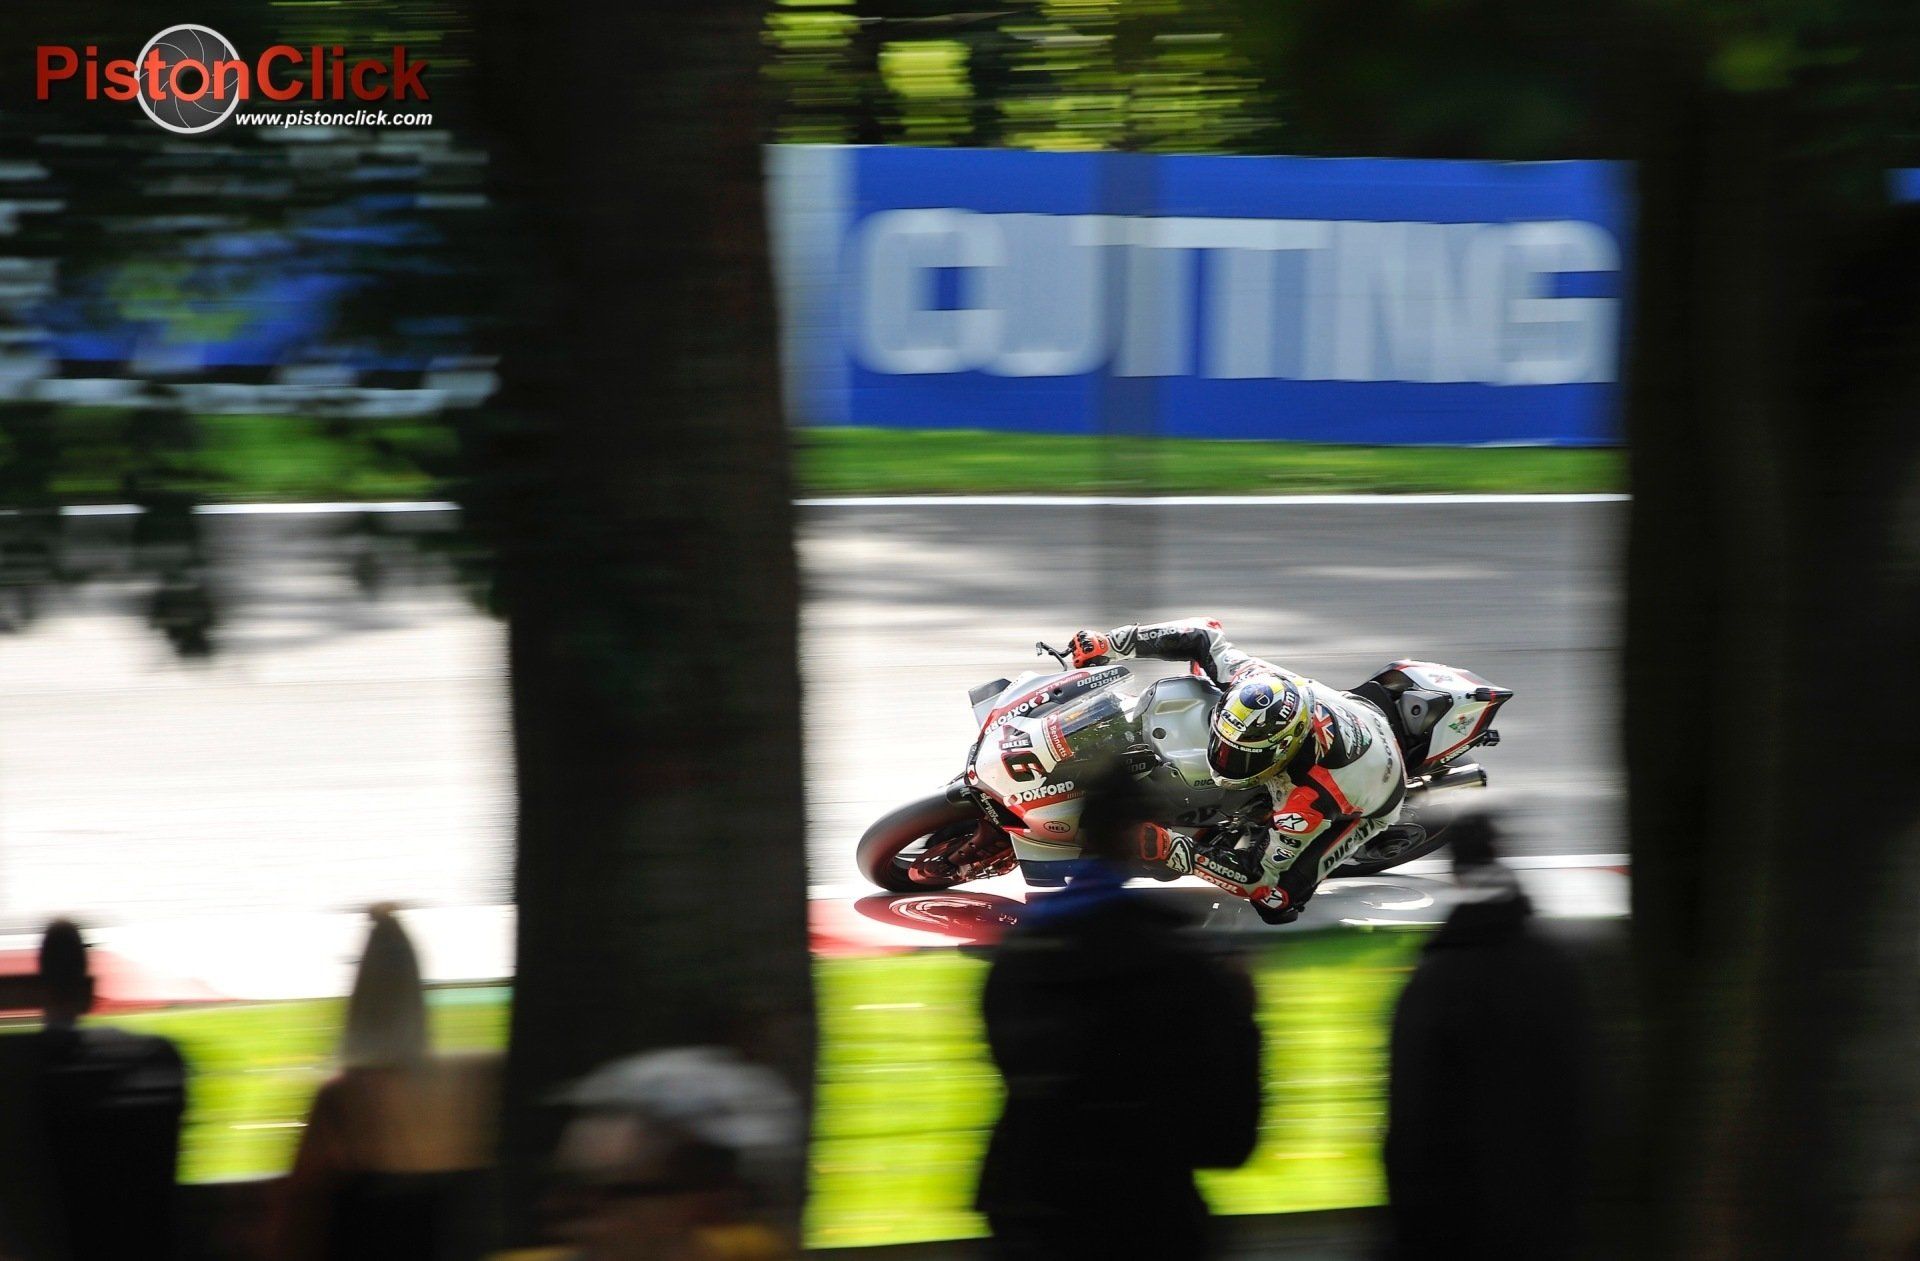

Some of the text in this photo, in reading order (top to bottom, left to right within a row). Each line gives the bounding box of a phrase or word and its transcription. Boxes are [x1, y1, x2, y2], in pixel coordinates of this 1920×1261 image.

[1077, 668, 1119, 688] RAPIDO
[1049, 724, 1067, 758] Bennetts
[1022, 780, 1075, 802] OXFORD
[1323, 817, 1375, 871] DUCATI
[1193, 868, 1238, 894] MOTUL
[1209, 861, 1248, 883] OXFORD
